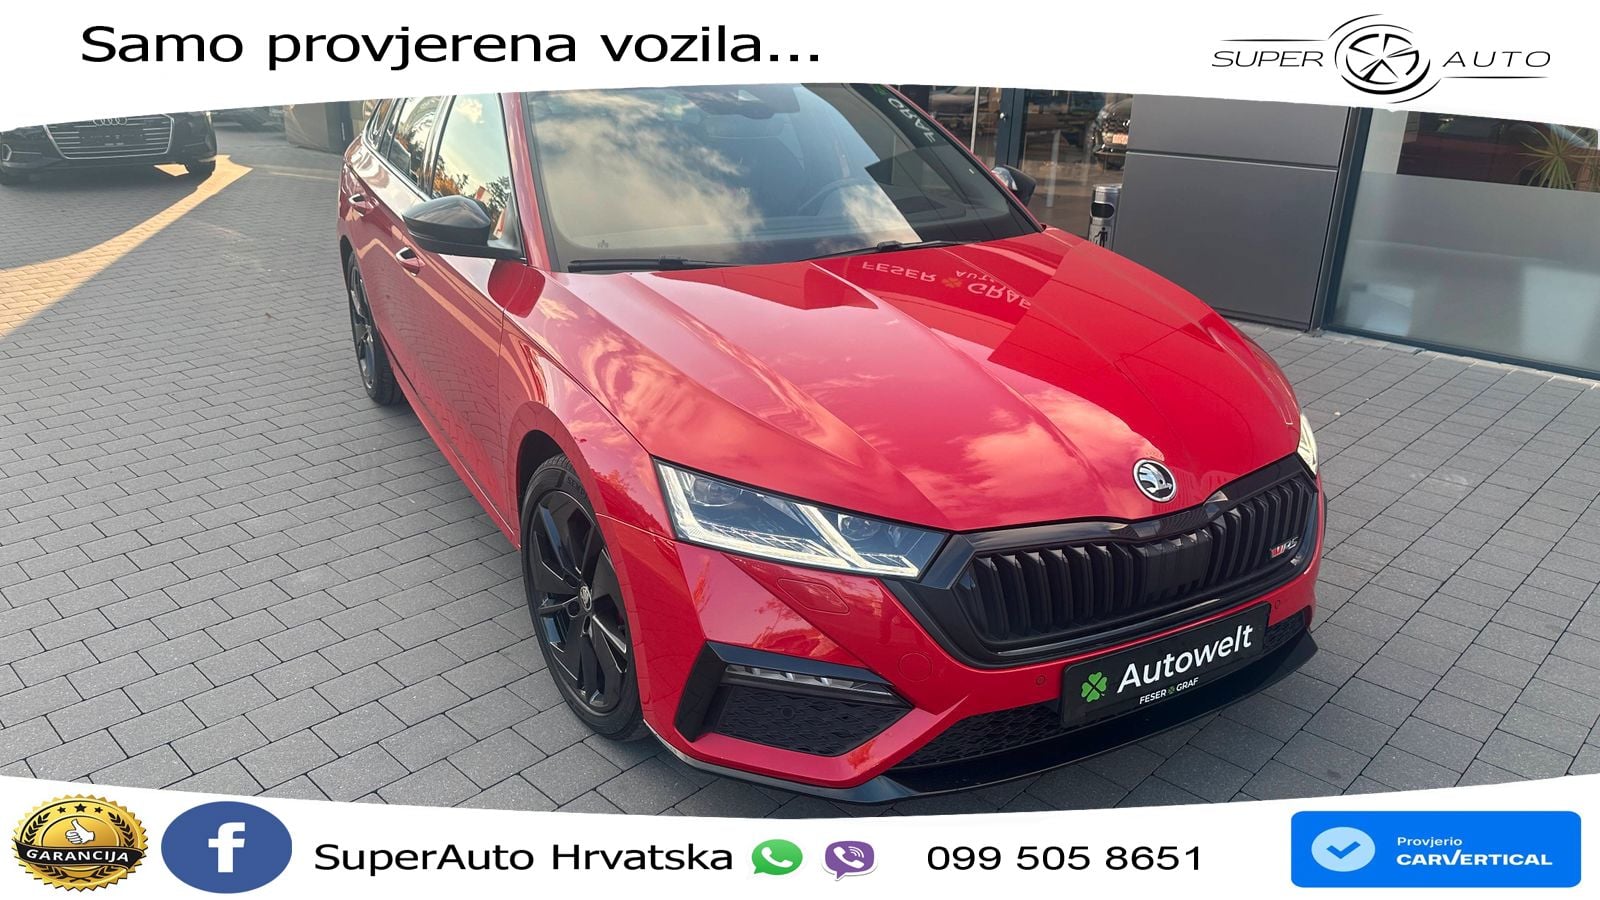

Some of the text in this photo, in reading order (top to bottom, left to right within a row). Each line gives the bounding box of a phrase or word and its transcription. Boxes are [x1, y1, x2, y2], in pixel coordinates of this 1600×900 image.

[1116, 624, 1253, 694] Autowelt
[1139, 677, 1200, 705] FESER GRAF
